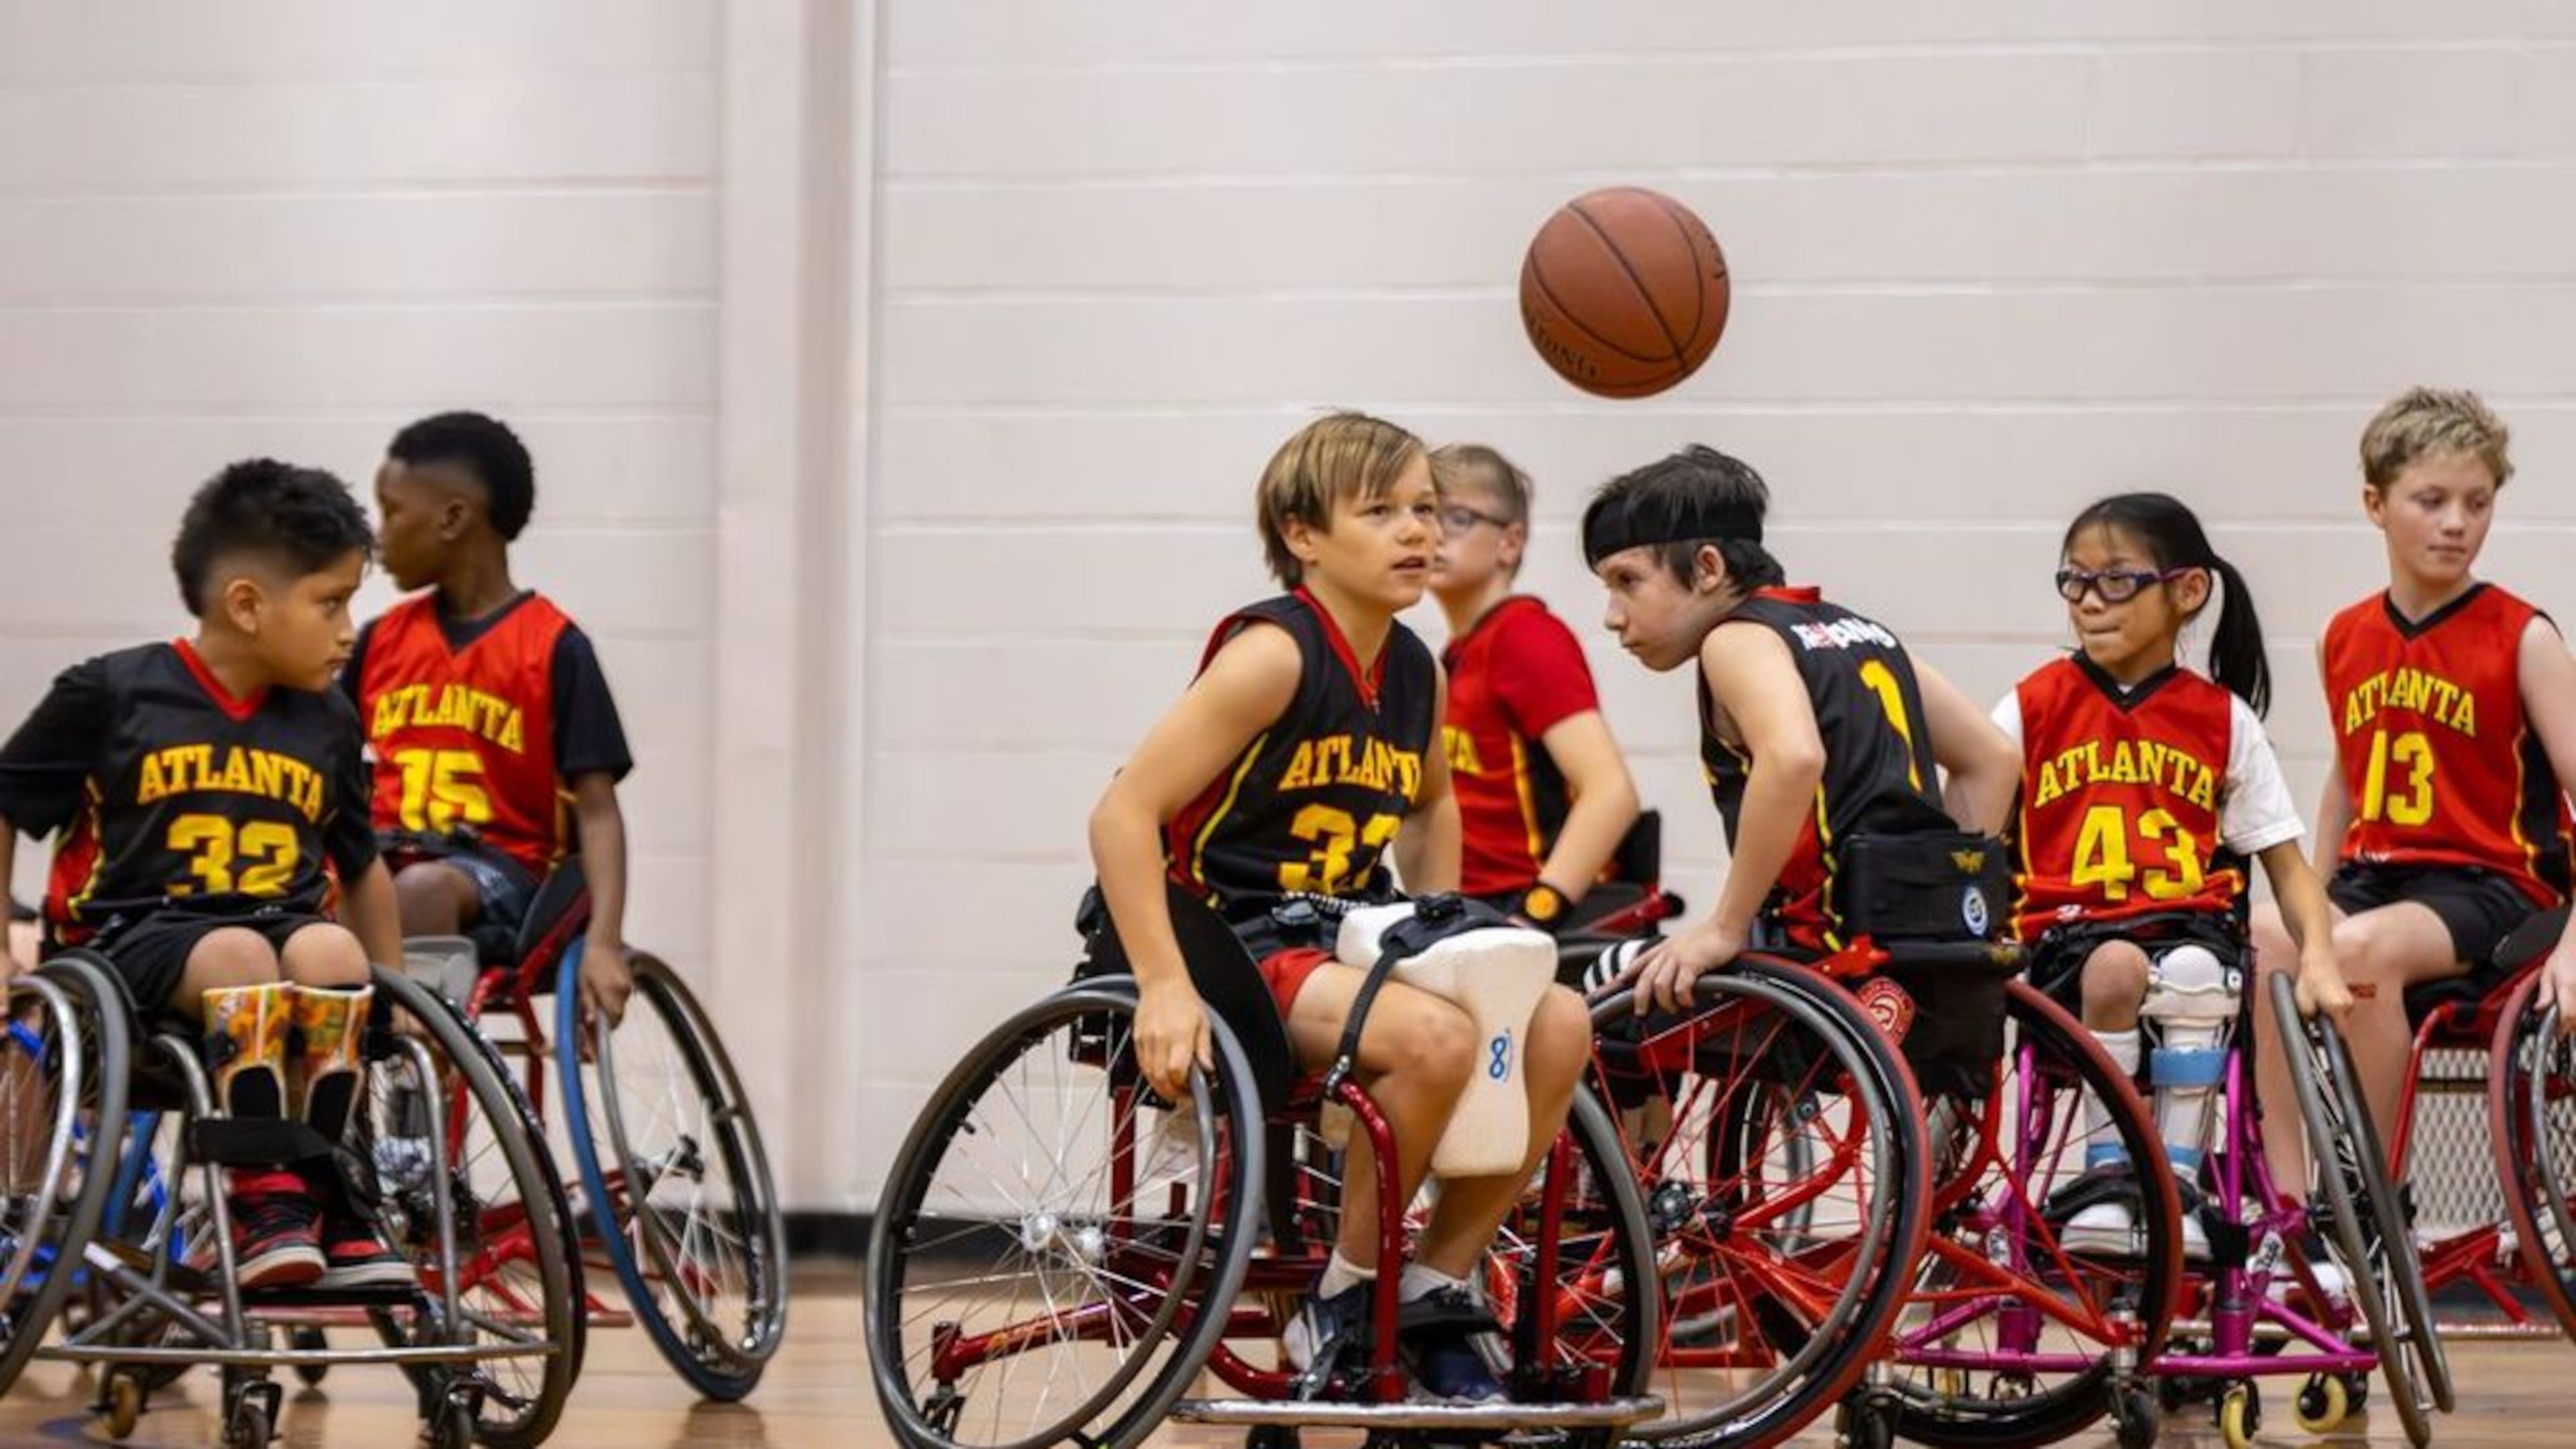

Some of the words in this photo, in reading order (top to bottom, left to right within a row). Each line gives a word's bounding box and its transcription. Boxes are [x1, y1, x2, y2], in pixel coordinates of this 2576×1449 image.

[373, 684, 523, 753] ATLANTA
[1859, 659, 1922, 792] 1
[2345, 667, 2475, 737] ATLANTA
[138, 743, 323, 820] ATLANTA
[393, 748, 494, 835] 15
[2035, 739, 2214, 812] ATLANTA
[2361, 729, 2435, 826] 13
[167, 814, 300, 896] 32
[2071, 804, 2204, 901] 43
